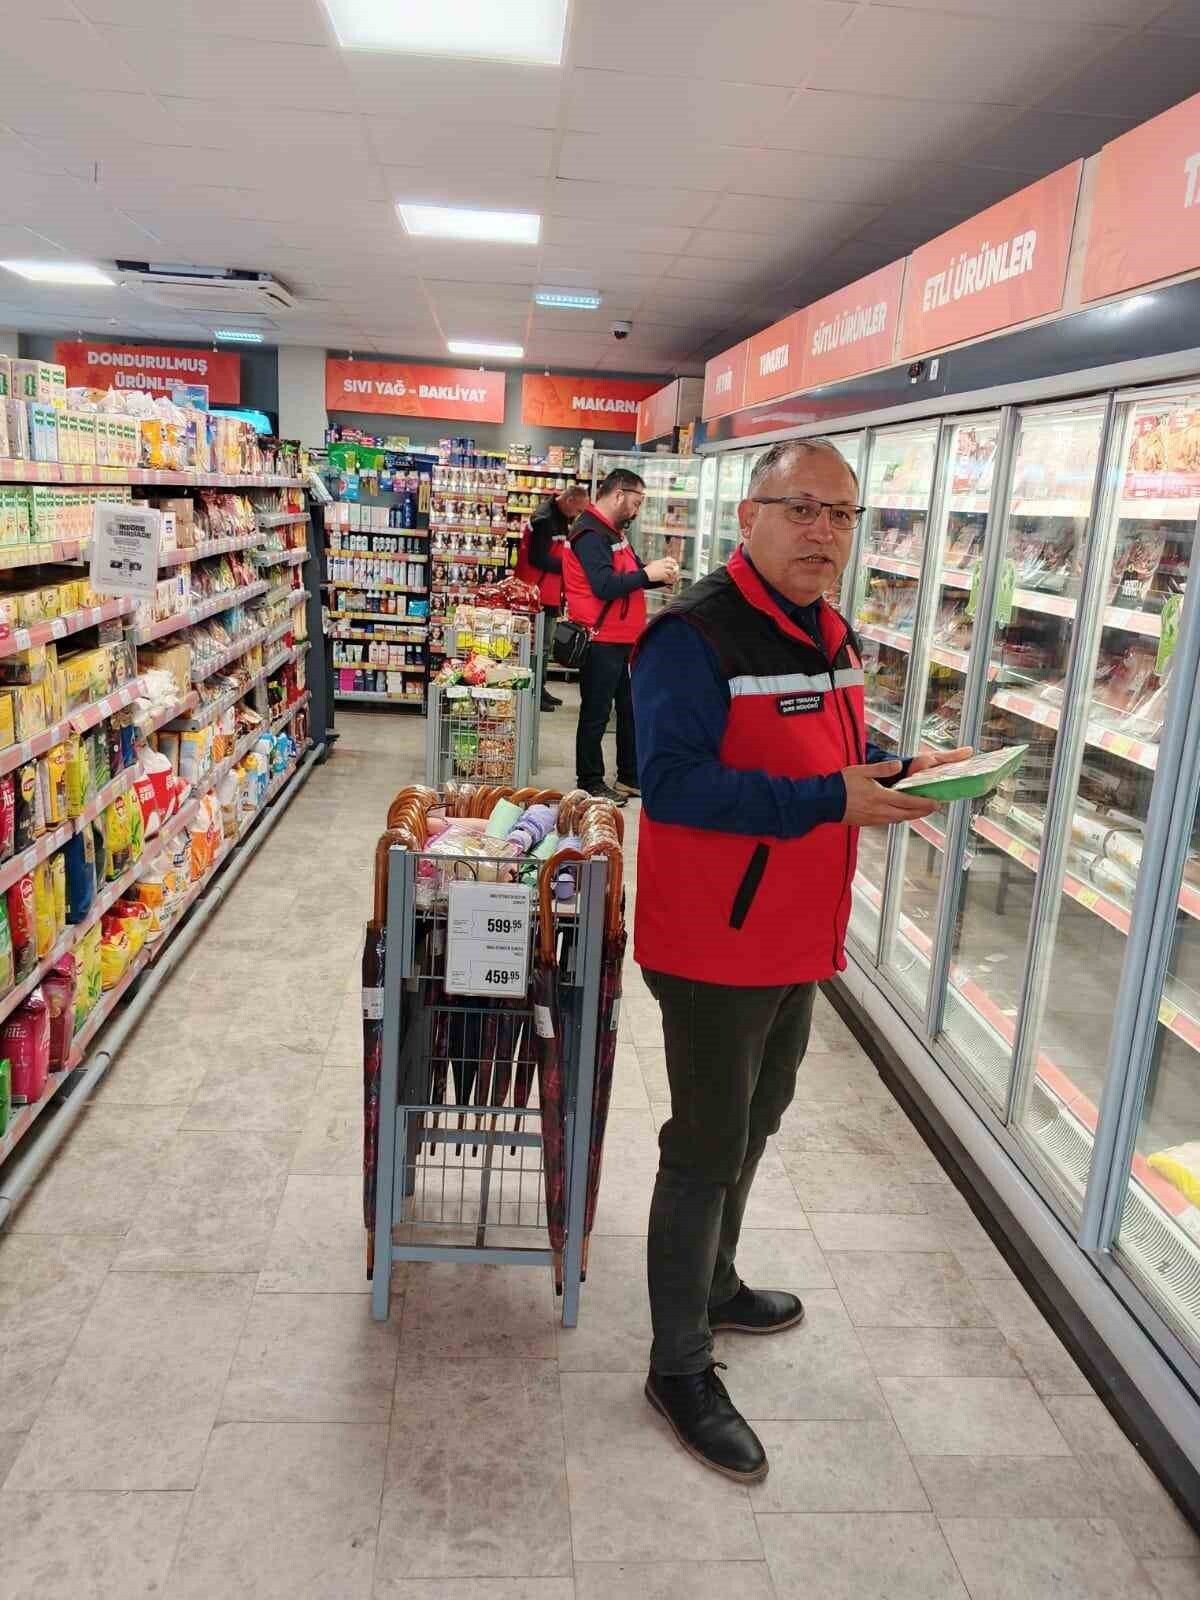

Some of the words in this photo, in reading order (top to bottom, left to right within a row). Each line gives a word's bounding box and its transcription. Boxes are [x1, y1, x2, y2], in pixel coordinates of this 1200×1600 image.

[922, 258, 956, 312] ETLİ
[953, 230, 1037, 300] ÜRÜNLER
[811, 313, 841, 356] SÜTLÜ
[839, 302, 888, 345] ÜRÜNLER
[87, 351, 208, 375] DONDURULMUŞ
[343, 378, 372, 394] SIVI
[375, 377, 406, 396] YAĞ
[418, 382, 488, 403] BAKLİYAT
